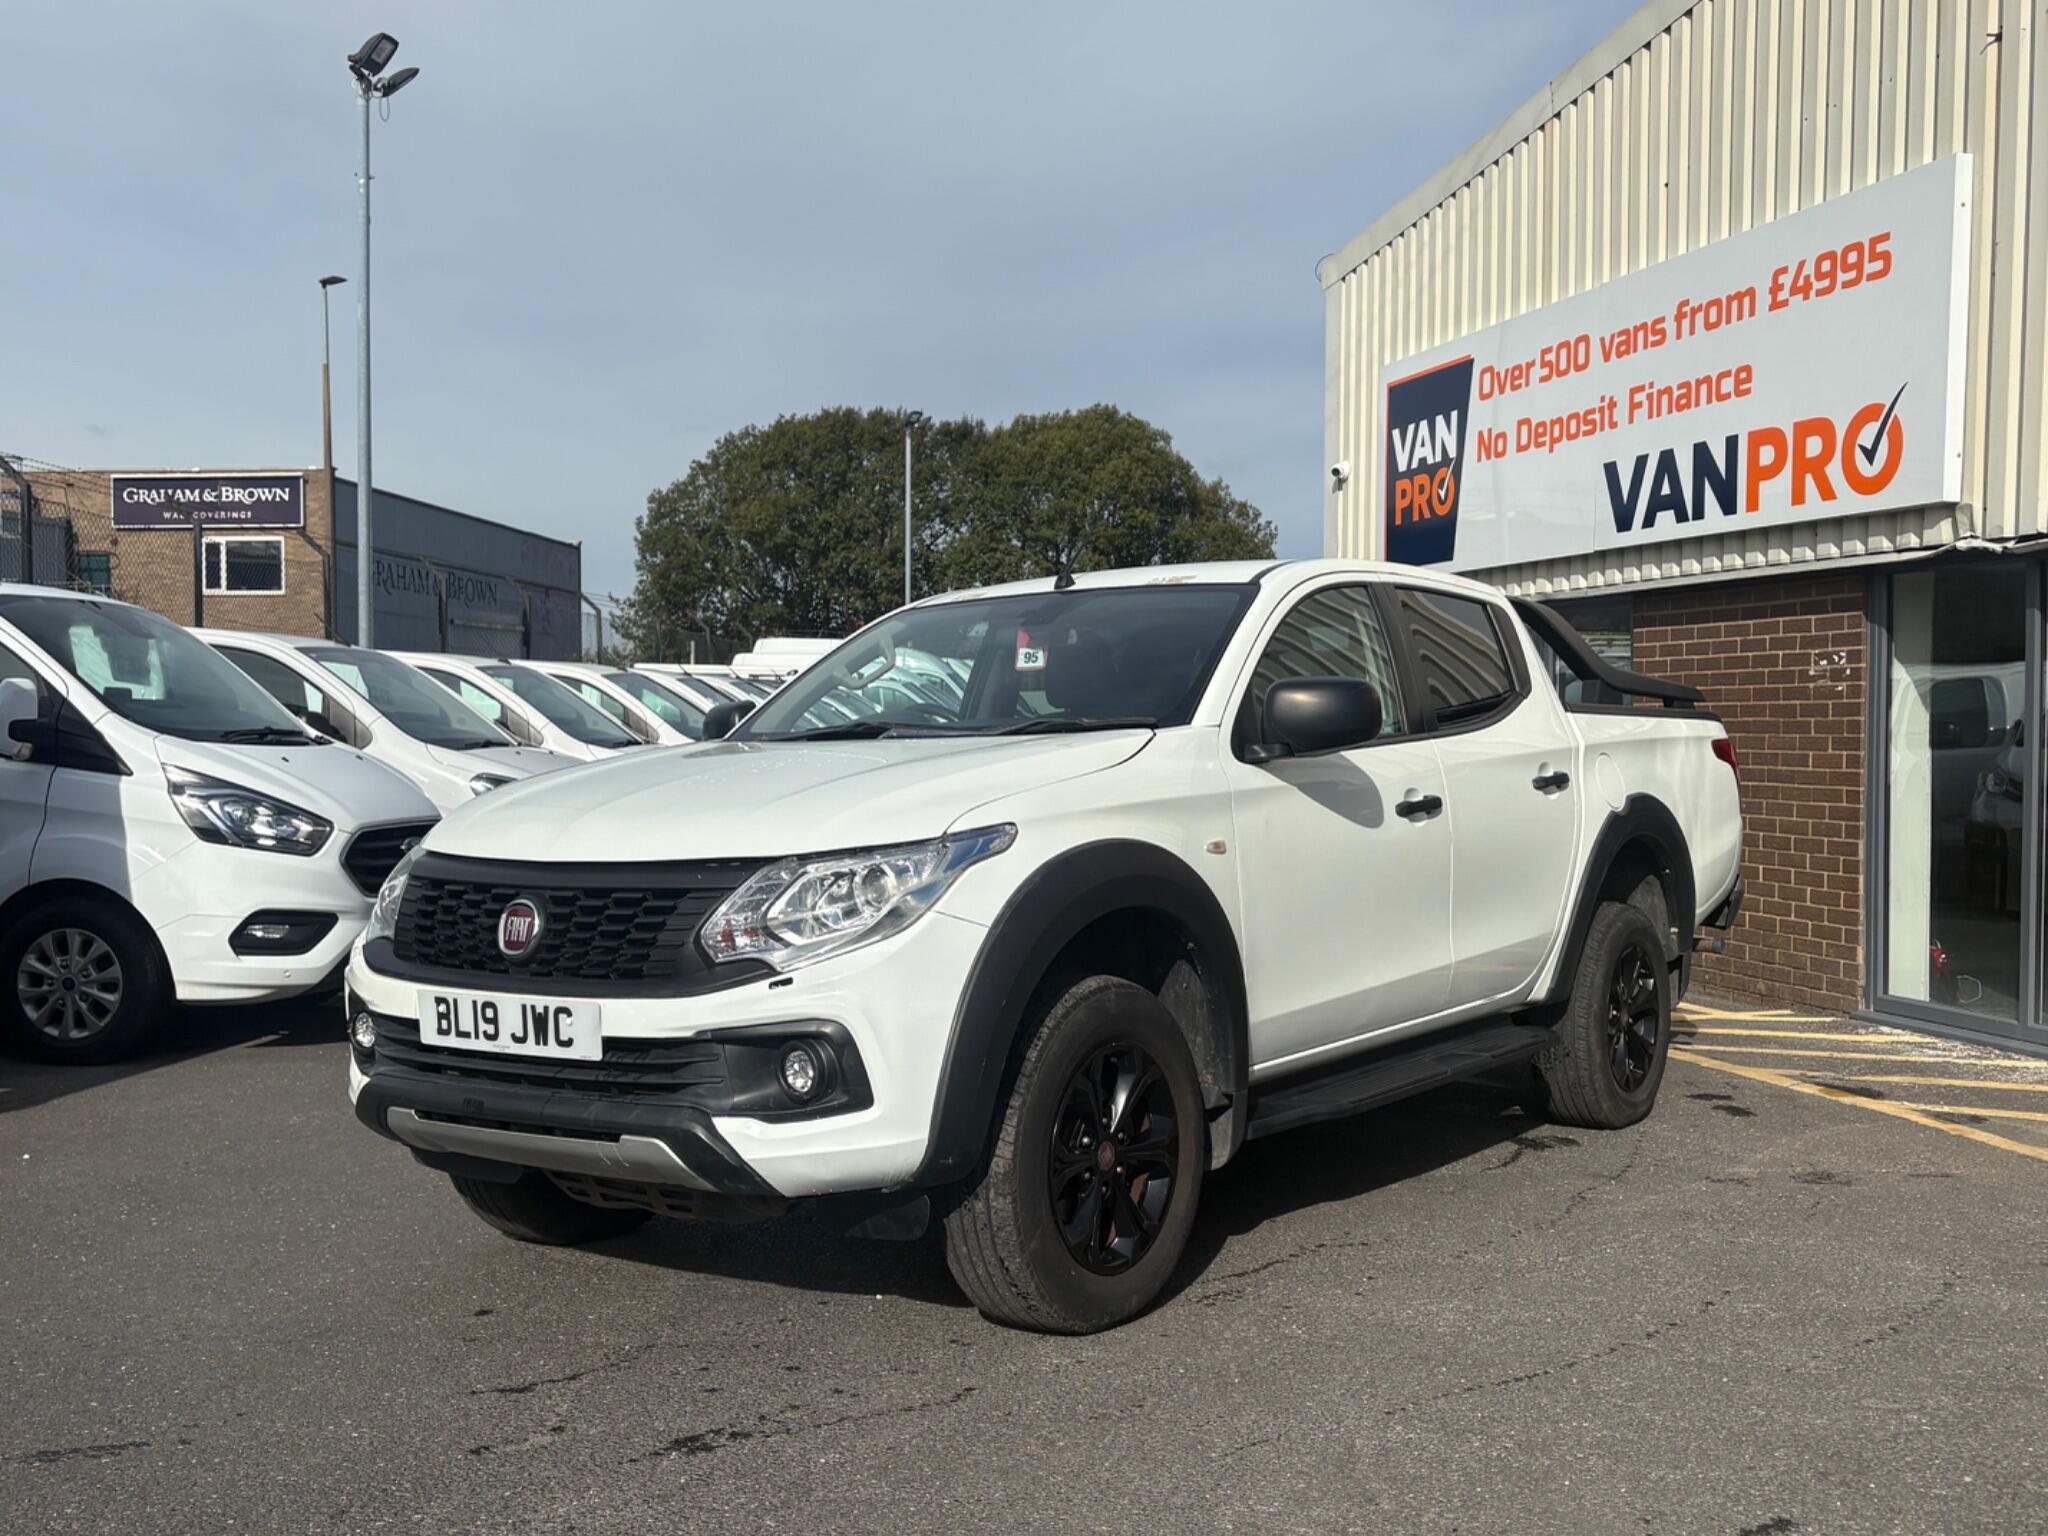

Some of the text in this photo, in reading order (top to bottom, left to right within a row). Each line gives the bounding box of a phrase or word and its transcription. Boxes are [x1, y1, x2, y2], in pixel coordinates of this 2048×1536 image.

[1478, 231, 1893, 401] Over 500 vans from £4995
[1476, 364, 1753, 464] No Deposit Finance
[1391, 409, 1458, 473] VAN
[163, 510, 188, 520] WA
[202, 487, 219, 503] &
[221, 486, 290, 505] BROWN
[1394, 466, 1456, 526] PRO
[374, 559, 430, 596] RAHAM
[1023, 650, 1039, 665] 95
[505, 915, 531, 942] FIAT
[434, 995, 574, 1048] BL19 JWC
